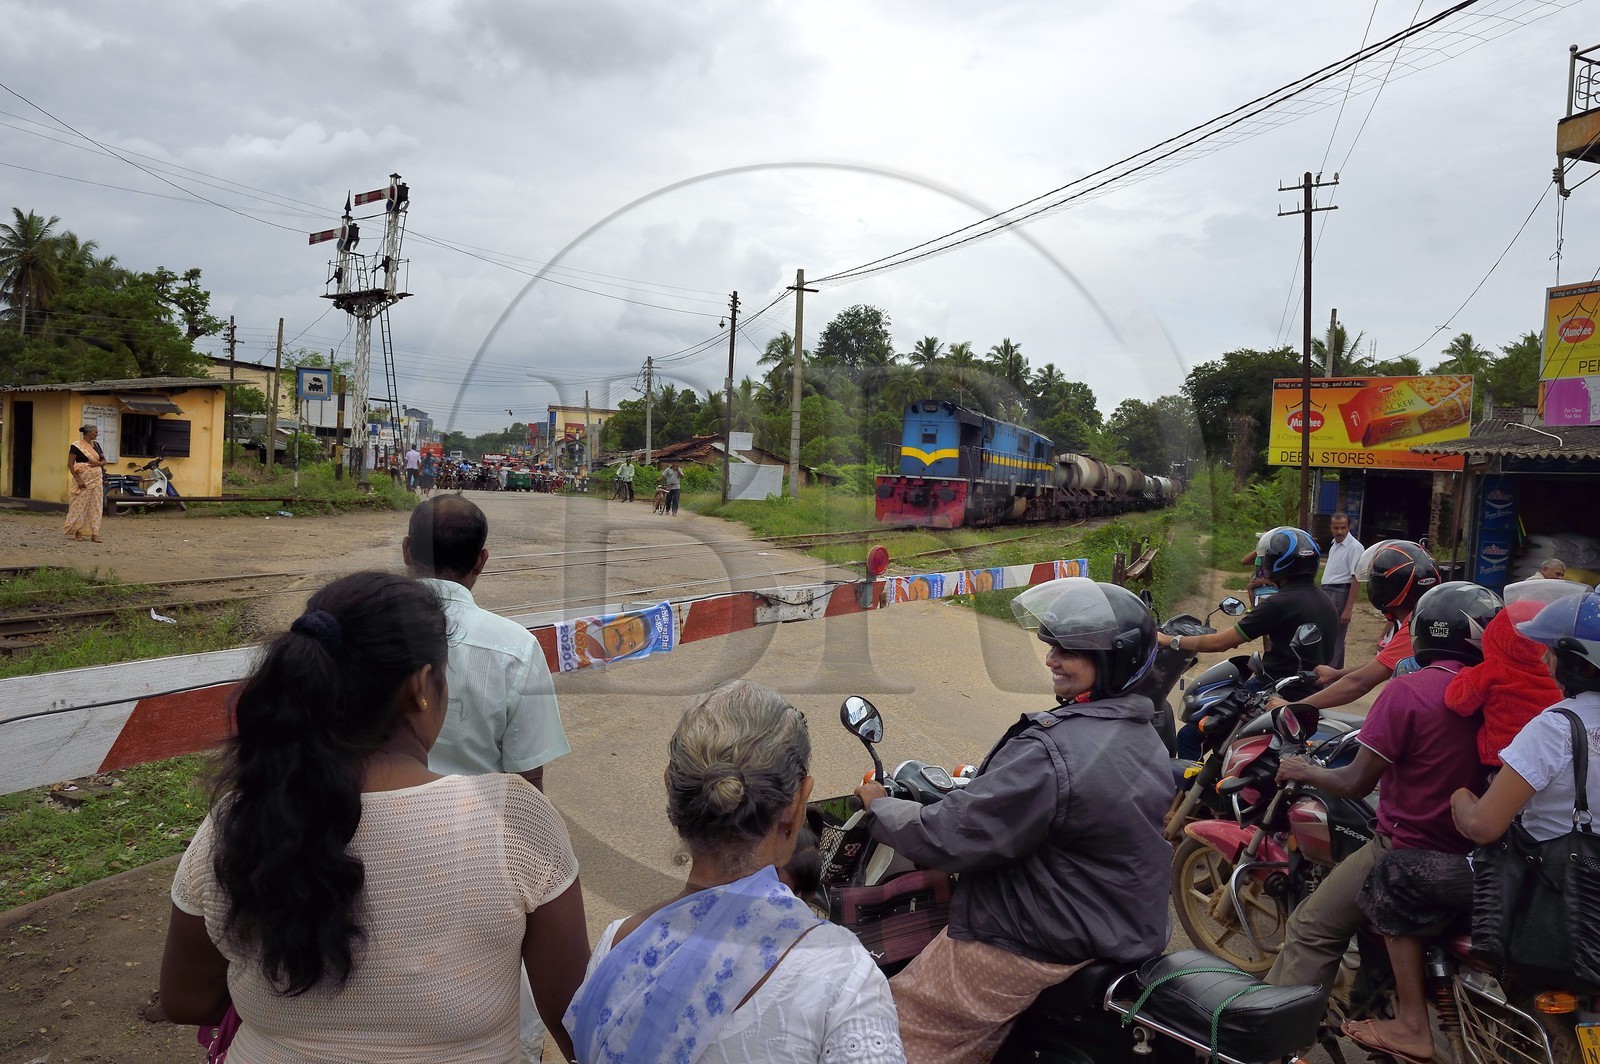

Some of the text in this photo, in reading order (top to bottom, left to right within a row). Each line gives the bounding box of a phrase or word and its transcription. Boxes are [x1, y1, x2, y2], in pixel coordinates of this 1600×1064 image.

[1375, 389, 1404, 401] SUPER
[1371, 399, 1415, 414] CRACKER
[1291, 417, 1322, 428] Muhee
[1280, 450, 1375, 465] DEEN STORES
